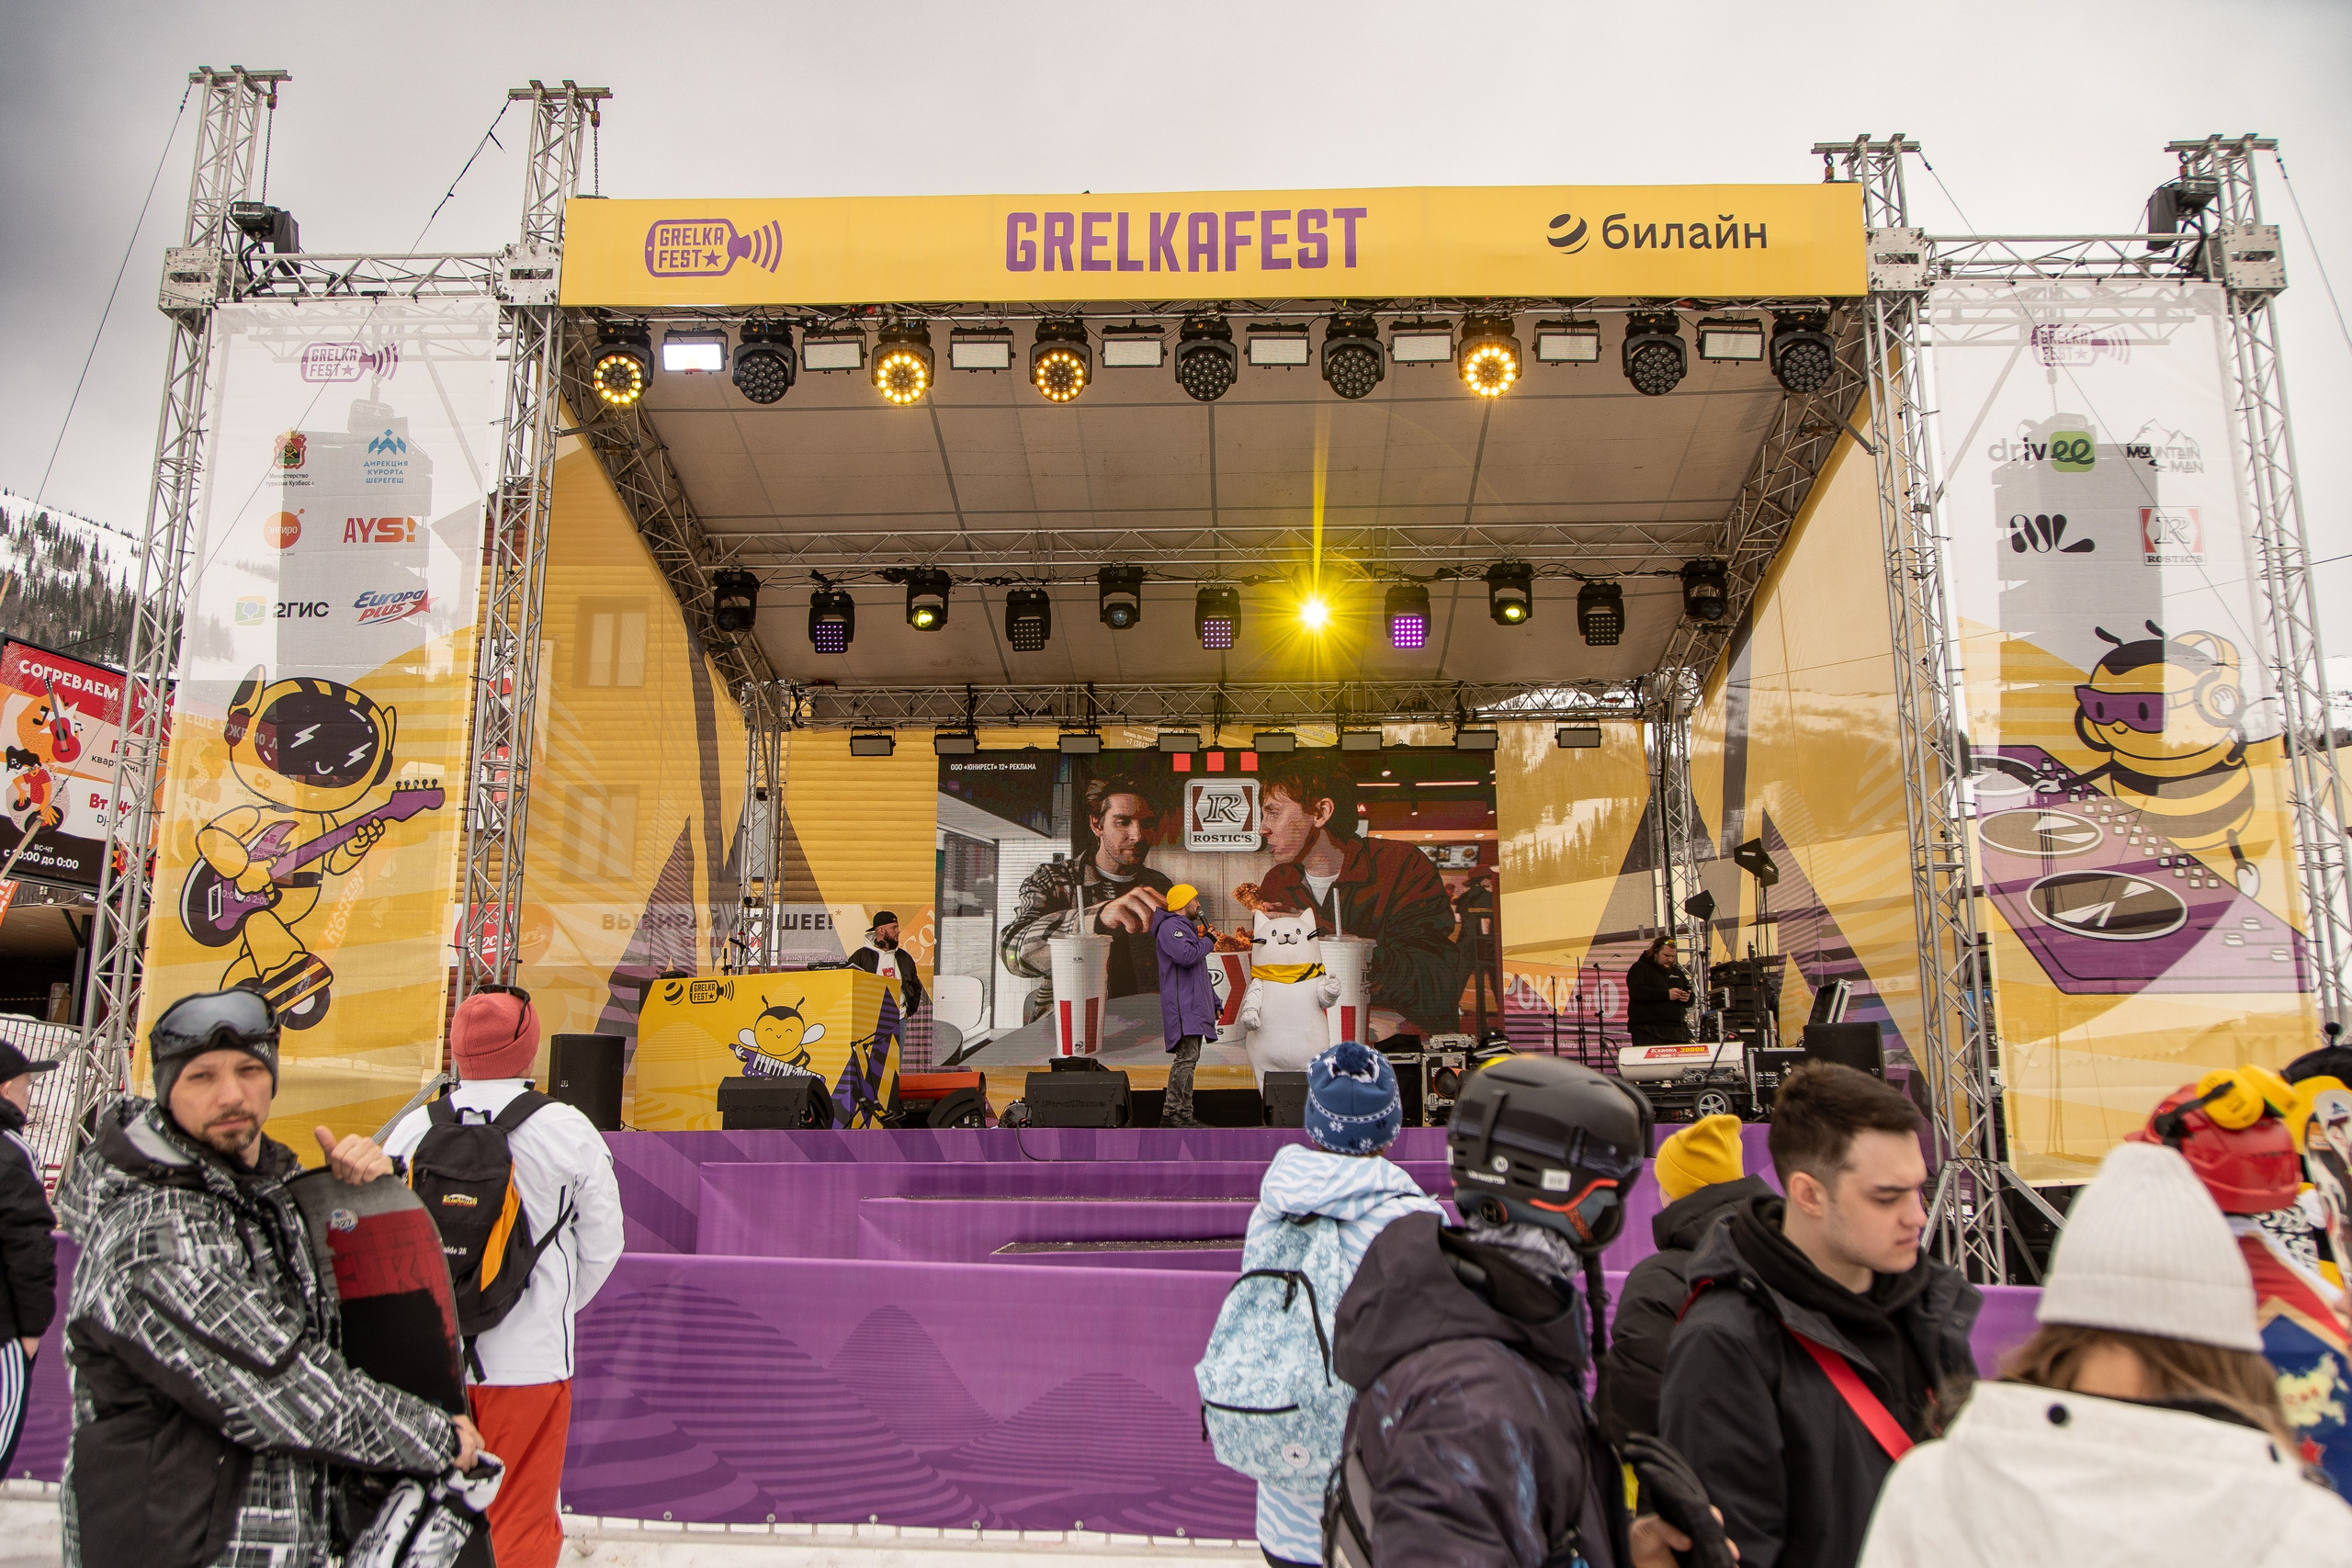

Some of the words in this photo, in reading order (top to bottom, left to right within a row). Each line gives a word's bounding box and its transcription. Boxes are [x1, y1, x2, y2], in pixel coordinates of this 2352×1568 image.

[660, 227, 724, 247] GRELKA
[1602, 212, 1768, 250] билайн
[1005, 207, 1367, 273] GRELKAFEST
[658, 249, 702, 268] FEST
[311, 347, 357, 362] GRELKA
[310, 363, 341, 378] FEST
[1987, 436, 2096, 466] drivee
[2126, 446, 2201, 460] MOUNTAIN
[2170, 460, 2204, 474] MAN
[343, 516, 416, 544] AYS!
[2146, 555, 2204, 563] ROSTIC'S
[354, 590, 425, 609] Europa
[273, 602, 330, 618] 2ГИС
[18, 658, 119, 702] СОГРЕВАЕМ
[1203, 794, 1242, 823] R
[1193, 834, 1253, 842] ROSTIC'S
[40, 855, 55, 865] до
[56, 856, 80, 871] 0:00
[694, 983, 716, 992] GRELKA
[694, 992, 708, 1001] FEST
